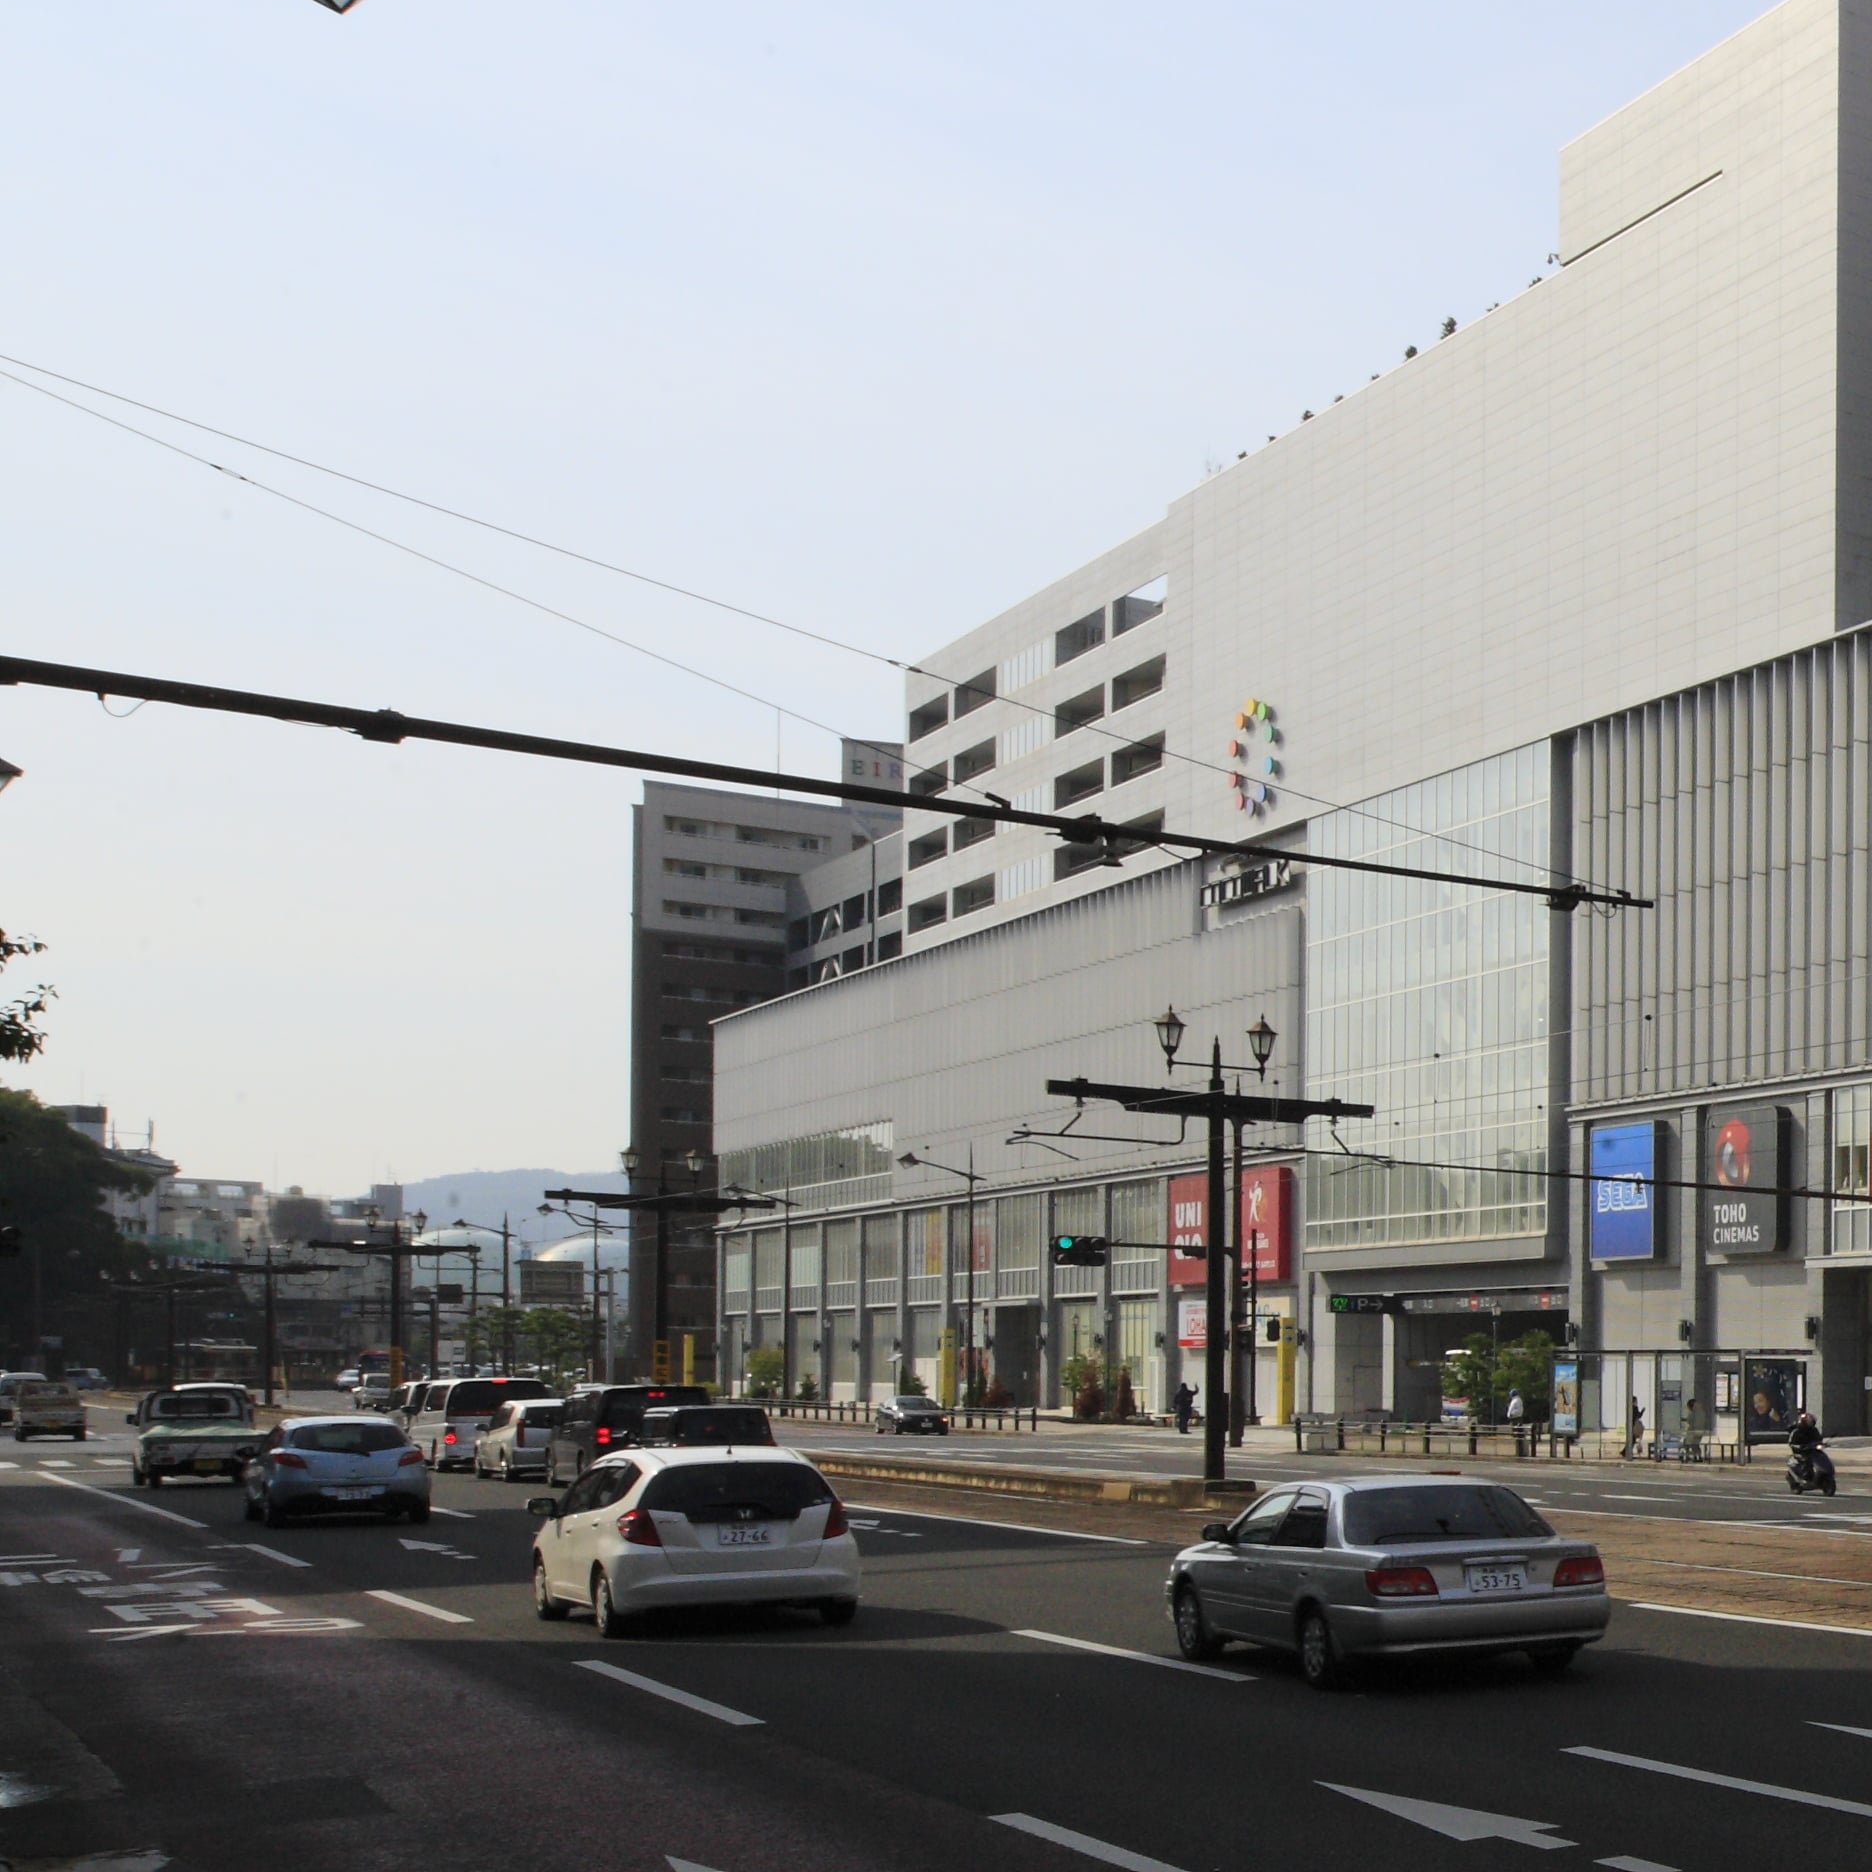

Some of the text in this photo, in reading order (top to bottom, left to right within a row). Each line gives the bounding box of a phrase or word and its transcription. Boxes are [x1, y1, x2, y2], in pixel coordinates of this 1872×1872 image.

[1597, 1171, 1648, 1212] SEGA
[1175, 1201, 1202, 1228] UNI
[1713, 1203, 1747, 1224] TOHO
[1713, 1225, 1760, 1244] CINEMAS
[1481, 1573, 1520, 1588] 53-75
